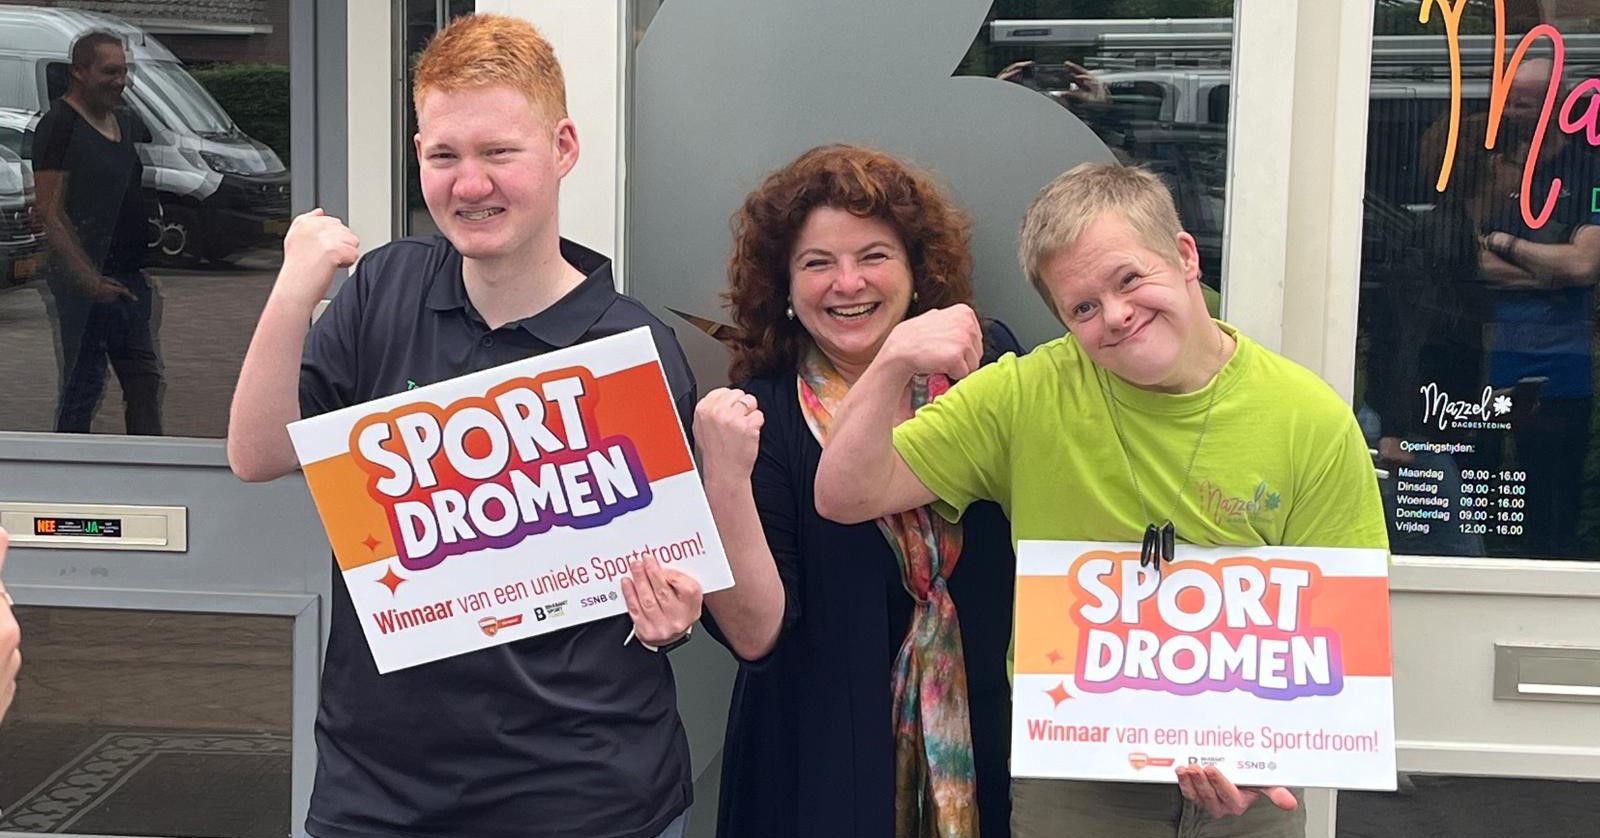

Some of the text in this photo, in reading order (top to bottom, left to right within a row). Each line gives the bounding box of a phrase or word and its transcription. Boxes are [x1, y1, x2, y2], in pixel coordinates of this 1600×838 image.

[1420, 382, 1493, 430] Mazzel
[357, 376, 589, 498] SPORT
[1400, 441, 1475, 454] Openingstijden:
[1398, 468, 1444, 481] Maandag
[1461, 470, 1489, 480] 09.00
[1499, 471, 1526, 481] 16.00
[1398, 482, 1438, 493] Dinsdag
[1460, 484, 1488, 494] 09.00
[1498, 485, 1525, 495] 16.00
[394, 445, 639, 559] DROMEN
[1397, 495, 1449, 507] Woensdag
[1459, 497, 1488, 507] 09.00
[1497, 498, 1525, 508] 16.00
[1396, 509, 1450, 521] Donderdag
[1459, 510, 1487, 521] 09.00
[1497, 512, 1524, 522] 16.00
[37, 520, 56, 533] NEE
[85, 522, 98, 533] JA
[1395, 521, 1429, 534] Vrijdag
[1459, 524, 1486, 534] 12.00
[1496, 525, 1523, 535] 16.00
[373, 599, 454, 635] Winnaar
[457, 590, 492, 613] van
[495, 582, 529, 603] een
[531, 559, 590, 595] unieke
[580, 594, 608, 608] SSNB
[1077, 558, 1311, 632] SPORT
[534, 607, 547, 621] B
[1084, 629, 1331, 689] DROMEN
[1028, 720, 1379, 753] Winnaar van een unieke Sportdroom!
[1237, 761, 1265, 769] SSNB
